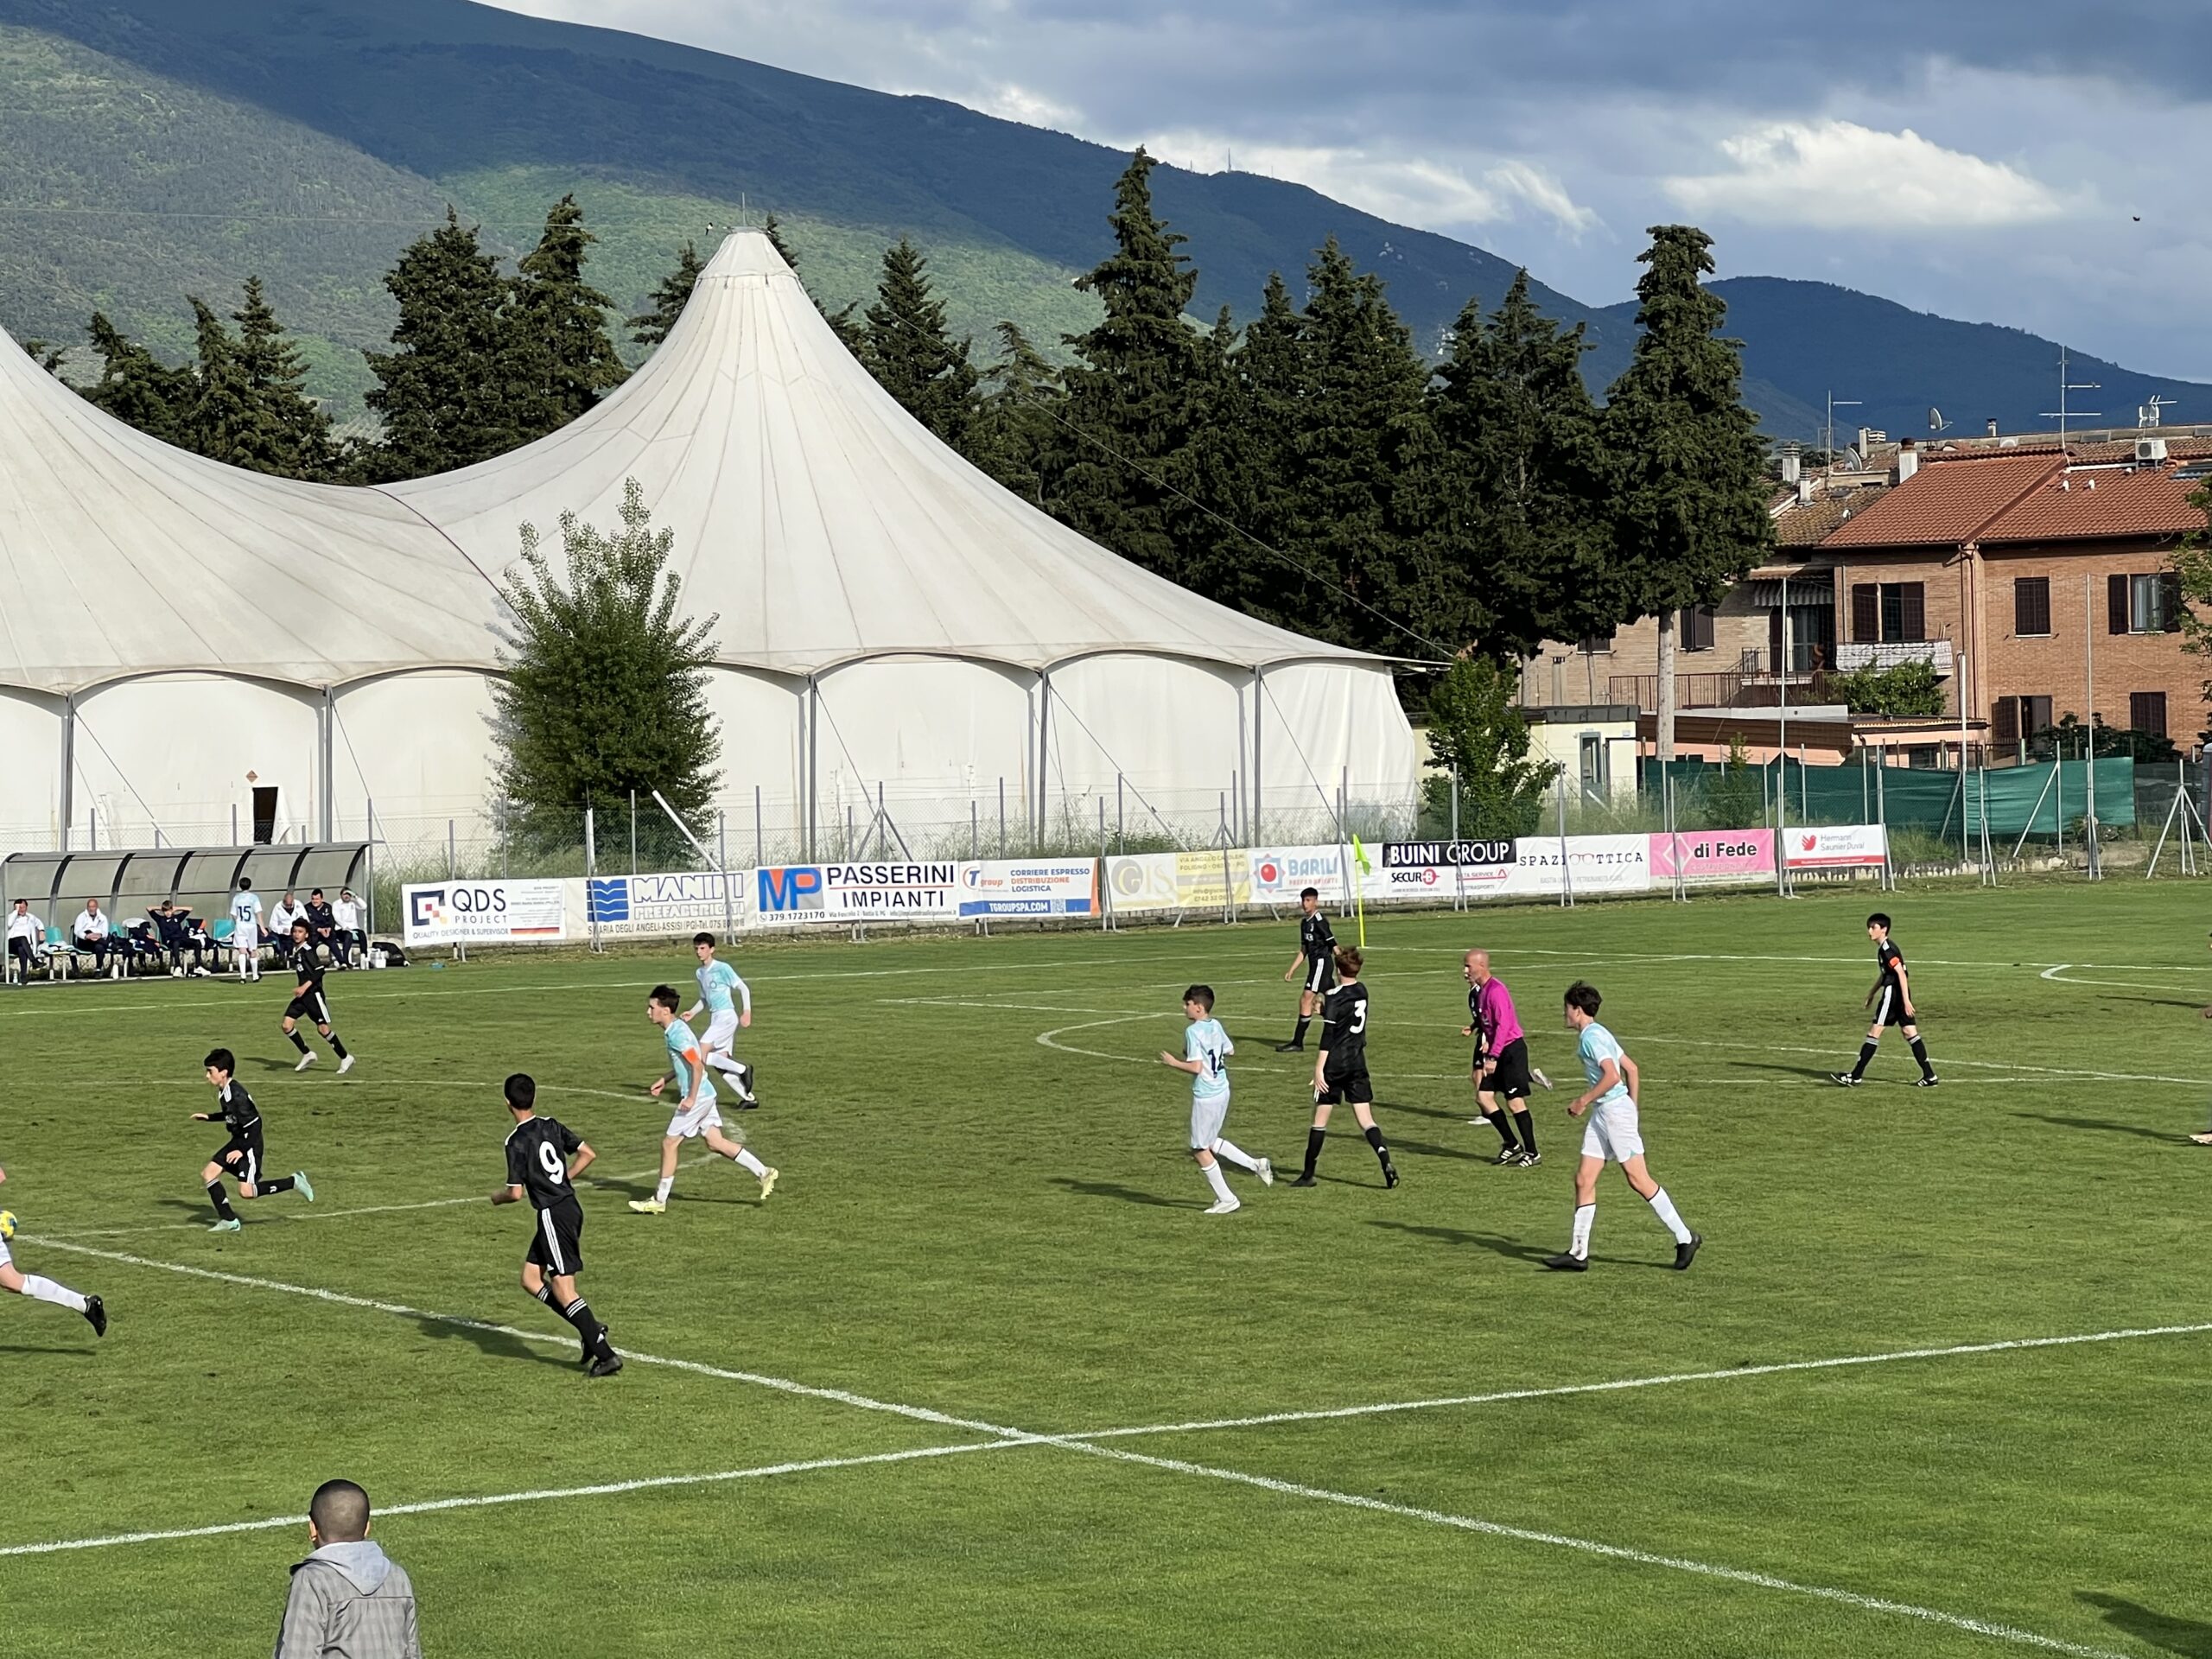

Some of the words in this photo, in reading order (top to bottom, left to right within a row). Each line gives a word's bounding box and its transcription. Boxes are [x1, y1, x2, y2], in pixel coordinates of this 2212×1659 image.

[1821, 834, 1852, 842] Hermann
[1390, 844, 1440, 865] BUINI
[1446, 842, 1510, 863] GROUP
[1694, 843, 1709, 858] di
[1716, 842, 1757, 856] Fede
[1821, 842, 1847, 851] Saunier
[827, 864, 954, 885] PASSERINI
[1288, 857, 1338, 876] BARILI
[1011, 876, 1071, 885] DISTRIBUZIONE
[452, 888, 506, 912] QDS
[842, 891, 944, 907] IMPIANTI
[238, 906, 251, 922] 15
[454, 915, 507, 925] PROJECT
[769, 912, 825, 921] 379.1723170
[412, 930, 439, 939] QUALITY
[442, 927, 470, 937] DESIGNER
[477, 927, 509, 936] SUPERVISOR
[616, 924, 634, 934] DEGLI
[1350, 999, 1367, 1034] 3
[539, 1141, 564, 1185] 9
